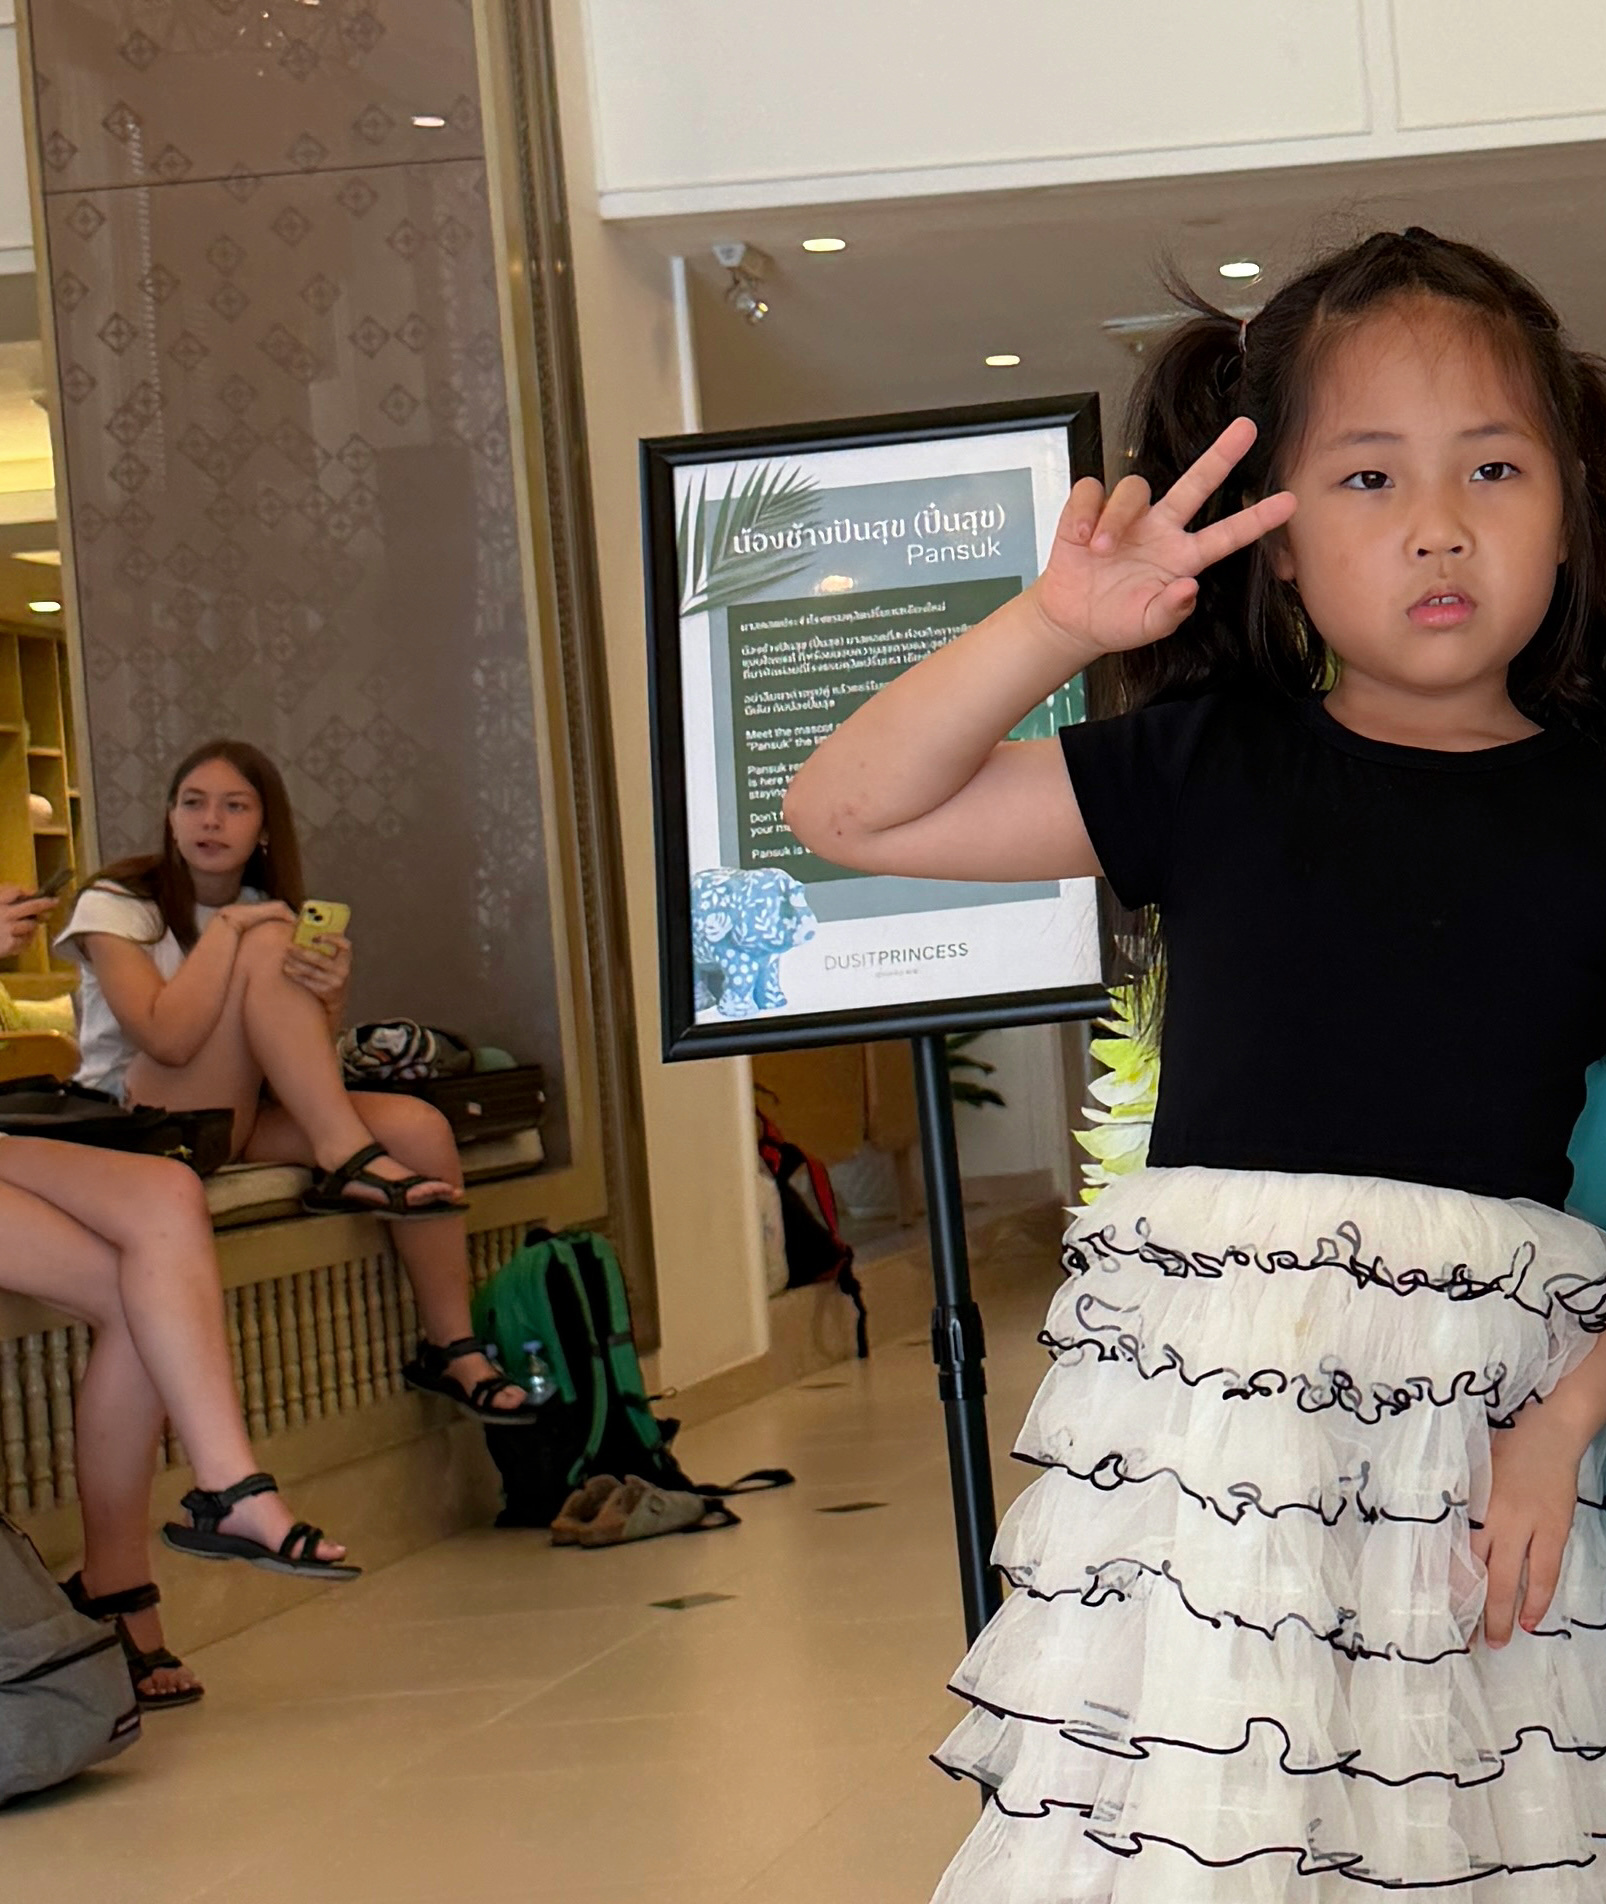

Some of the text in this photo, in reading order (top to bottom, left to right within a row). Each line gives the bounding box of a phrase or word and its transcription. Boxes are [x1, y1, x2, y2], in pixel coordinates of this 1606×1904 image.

[907, 536, 1001, 566] Pansuk
[747, 762, 787, 775] Pansuk
[750, 825, 774, 838] your
[752, 846, 791, 859] Pansuk
